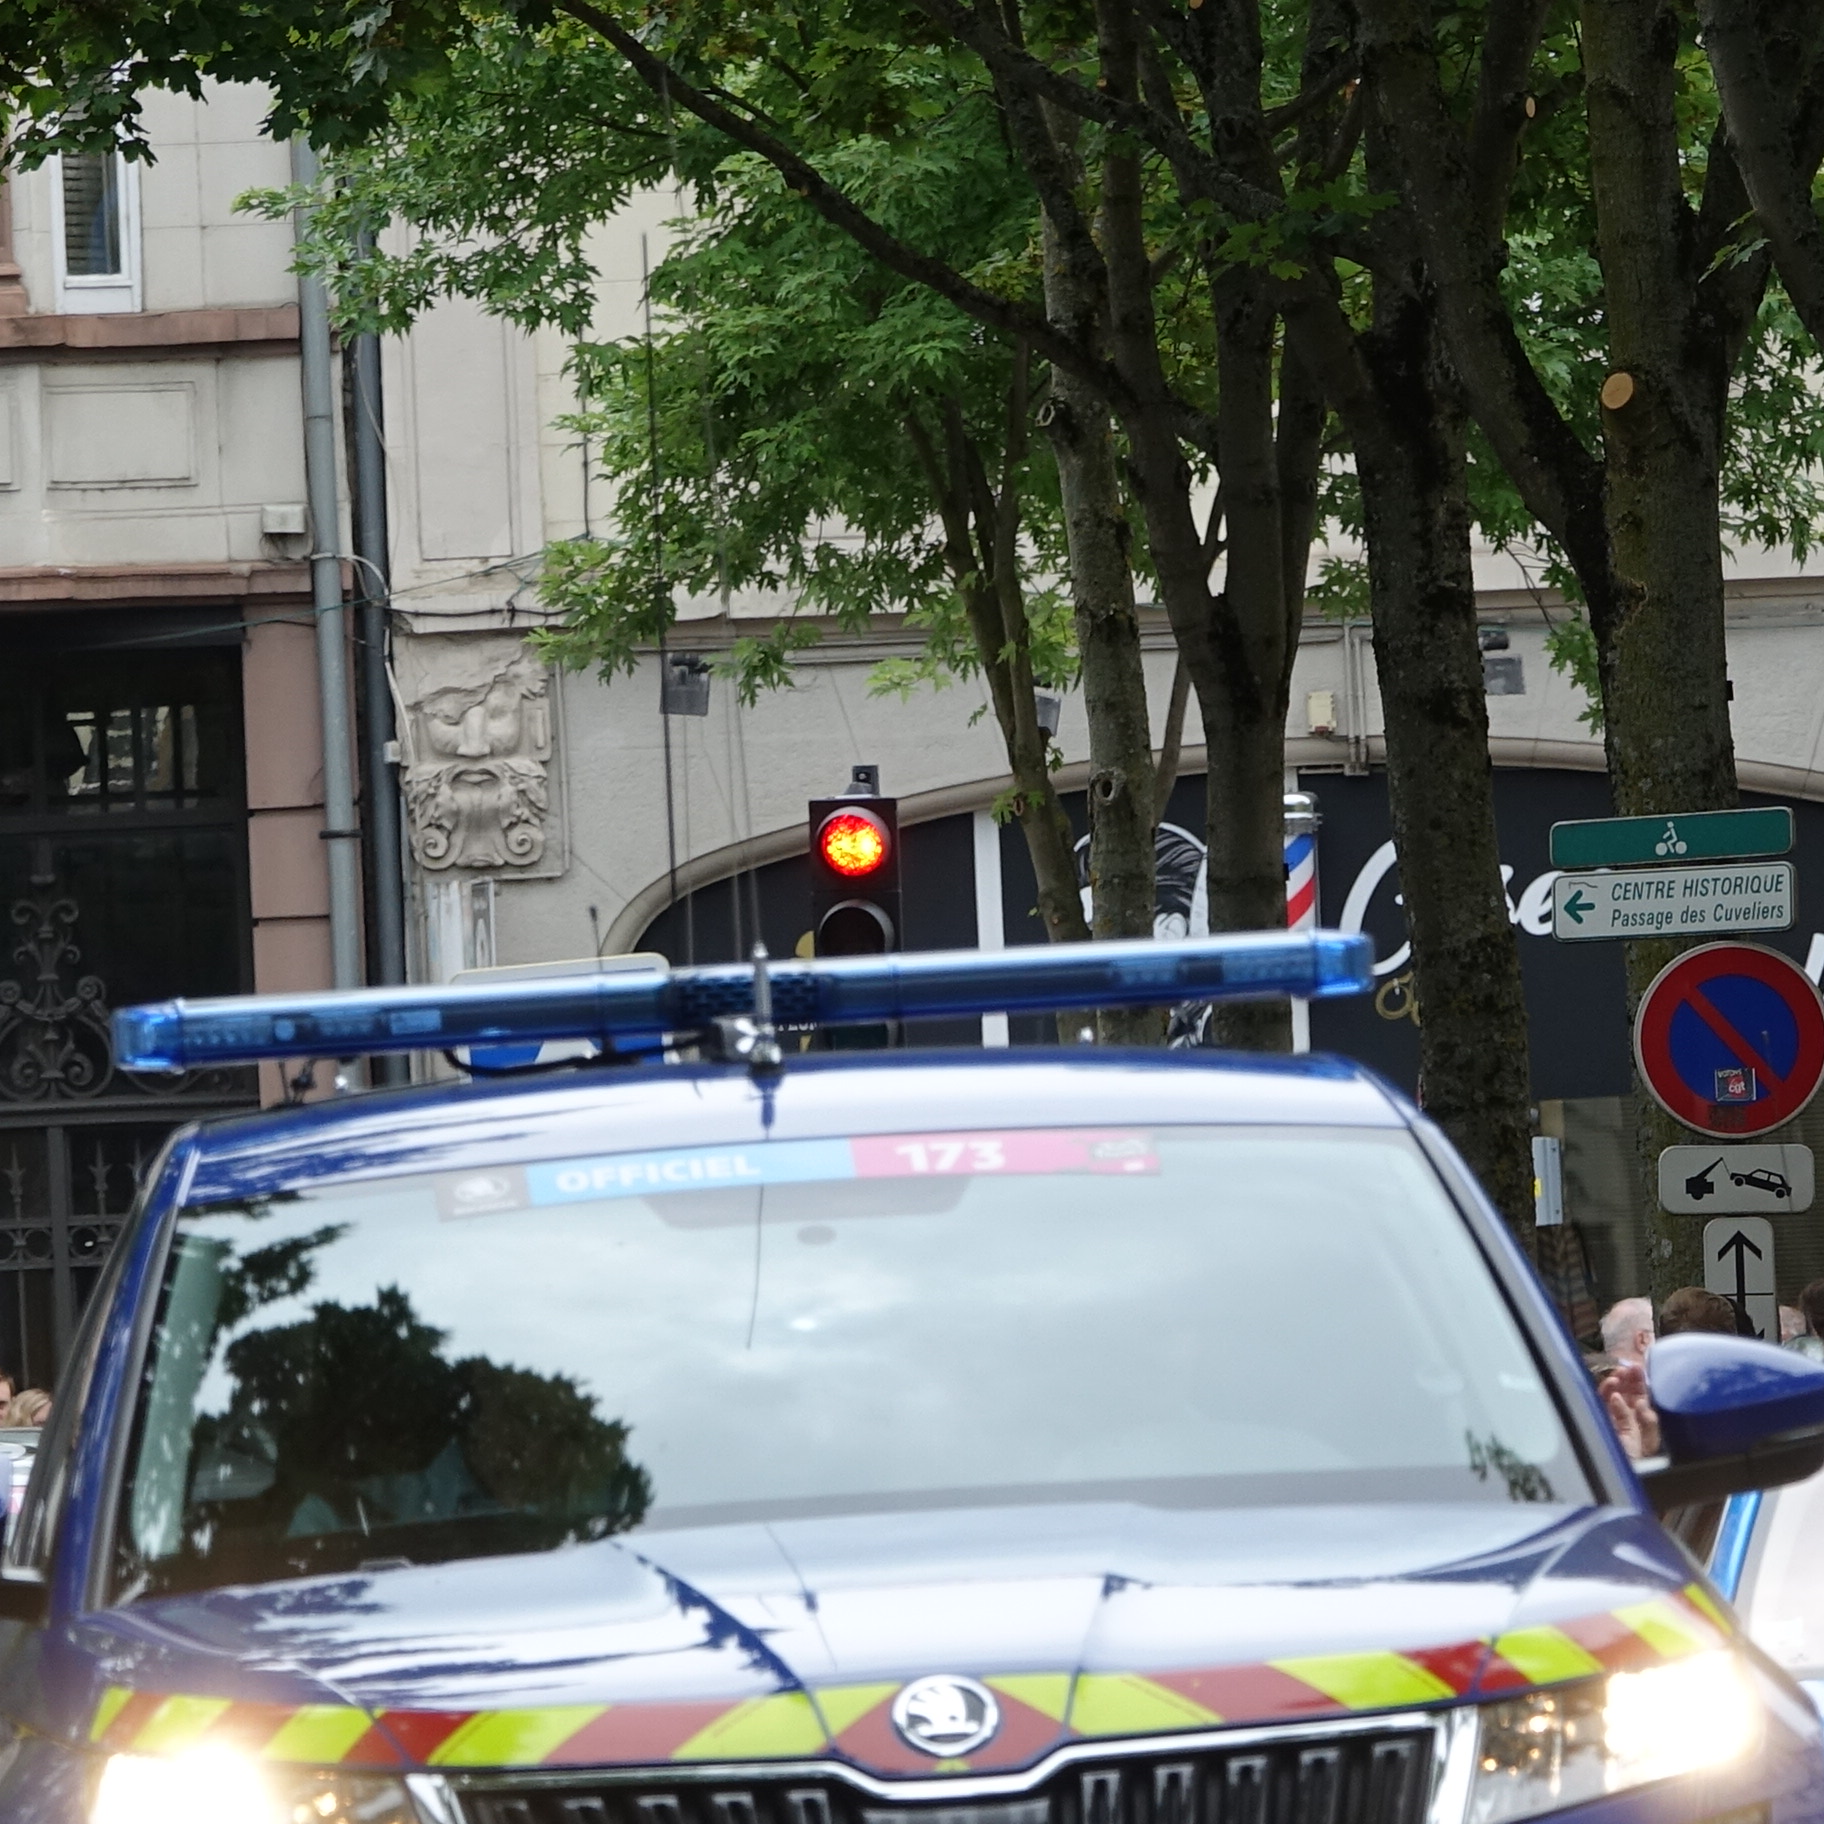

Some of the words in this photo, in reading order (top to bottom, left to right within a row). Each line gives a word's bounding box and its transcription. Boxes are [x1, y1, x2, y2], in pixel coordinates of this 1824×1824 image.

[1610, 880, 1676, 901] CENTRE
[1682, 873, 1785, 899] HISTORIQUE
[1610, 908, 1674, 930] Passage
[1680, 905, 1706, 925] des
[1713, 902, 1785, 923] Cuveliers
[555, 1156, 761, 1194] OFFICIEL
[894, 1141, 1006, 1172] 173
